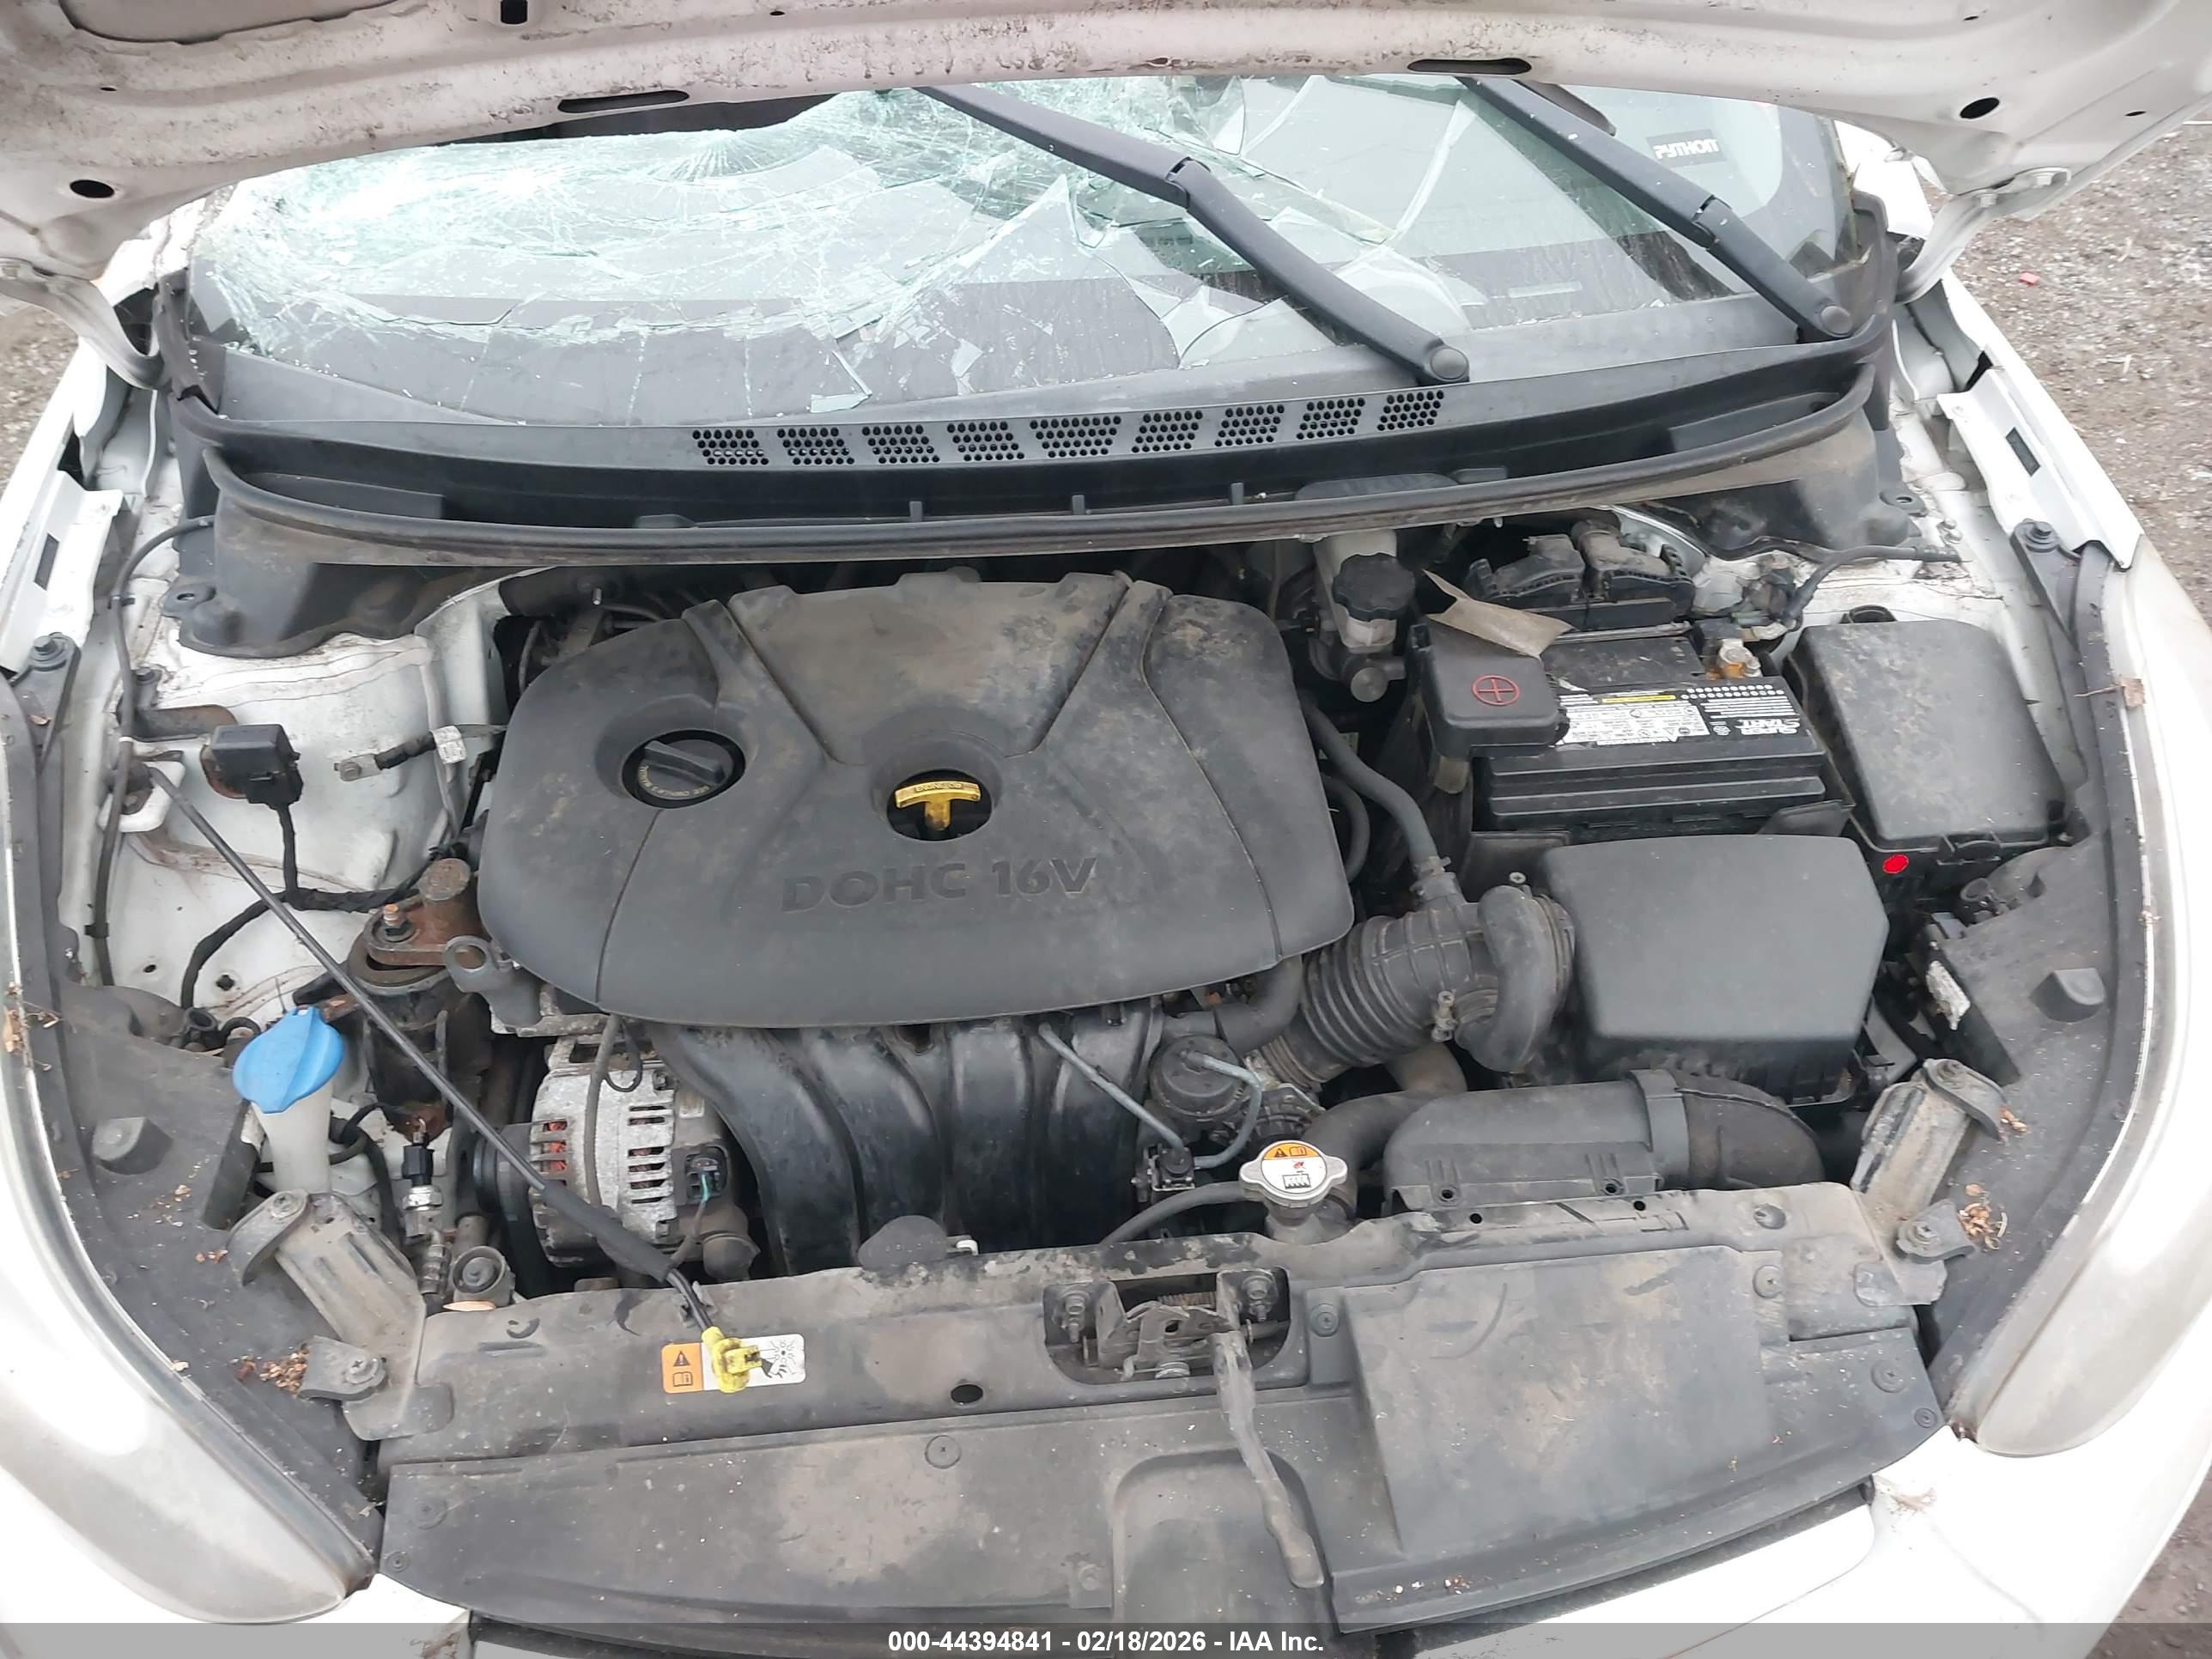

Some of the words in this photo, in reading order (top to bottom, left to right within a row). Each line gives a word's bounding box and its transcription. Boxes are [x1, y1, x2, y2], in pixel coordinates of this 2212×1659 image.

[1653, 139, 1719, 160] PYTHON
[781, 862, 967, 914] DOHC
[992, 858, 1098, 899] 16V
